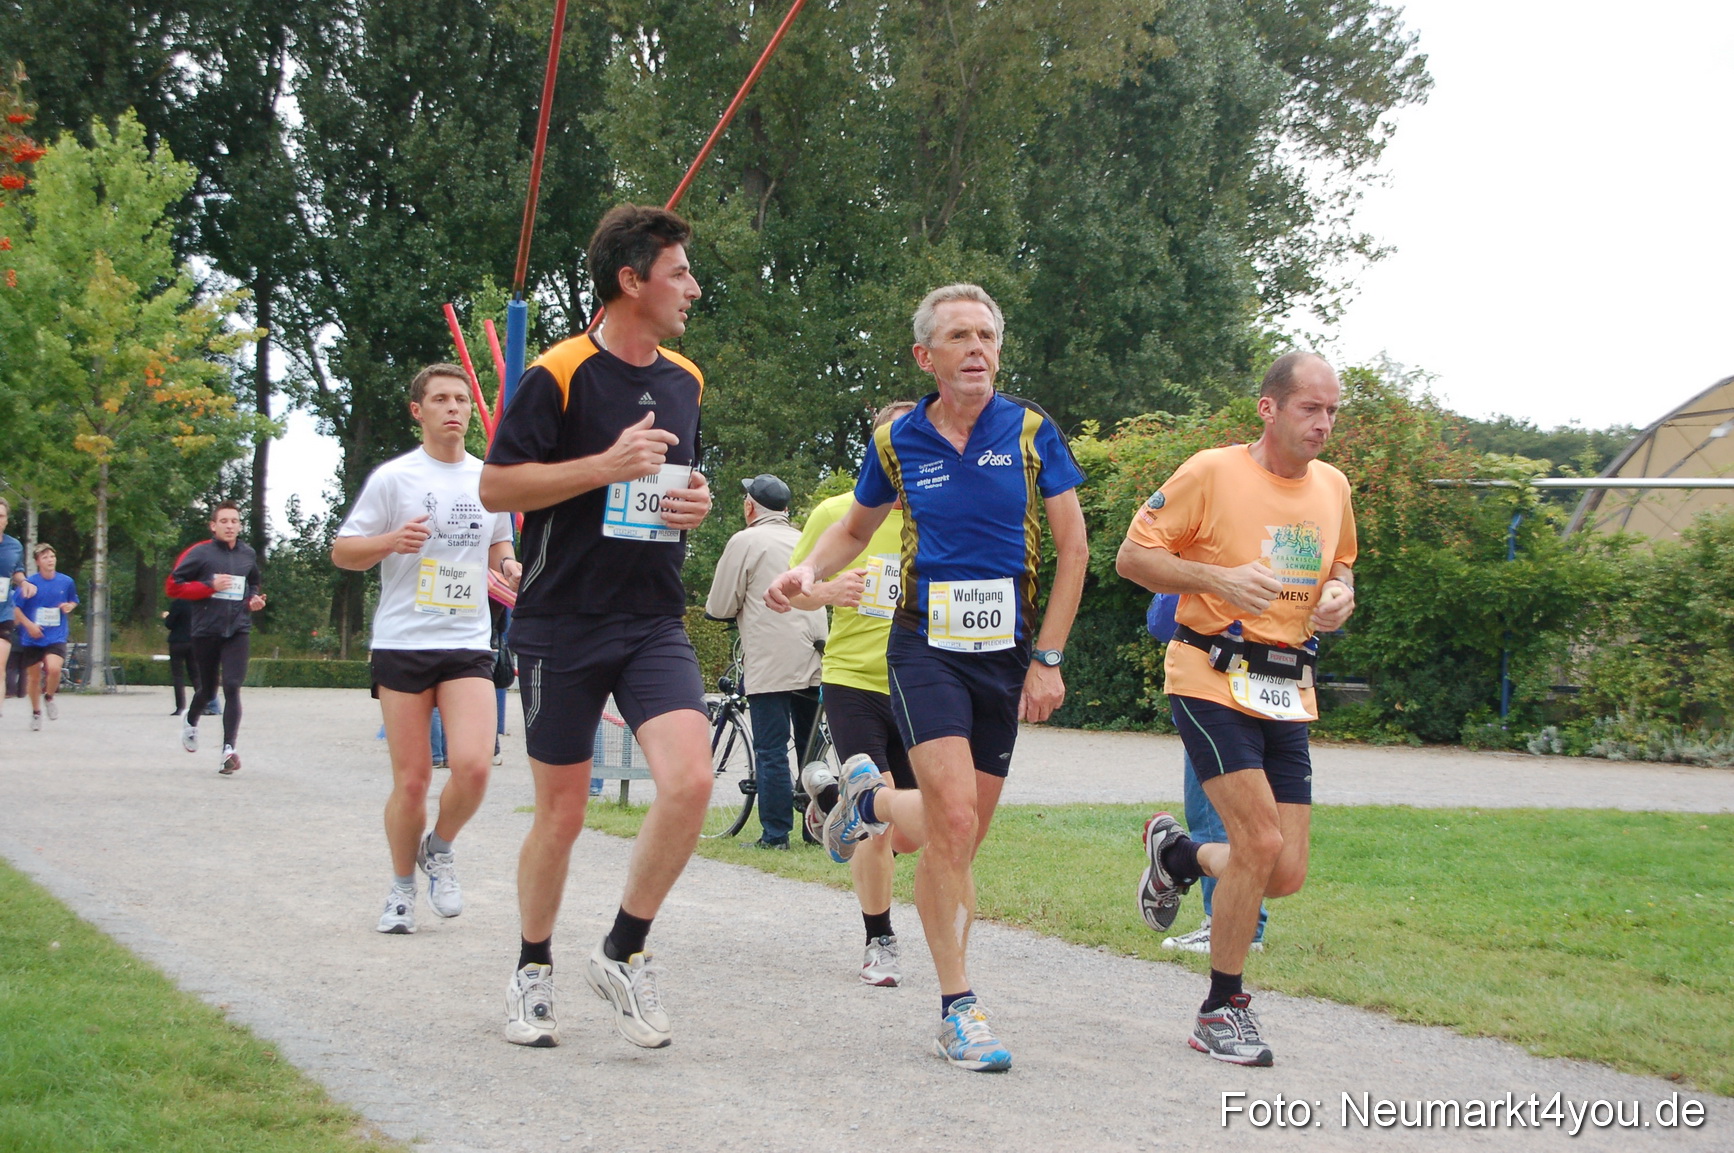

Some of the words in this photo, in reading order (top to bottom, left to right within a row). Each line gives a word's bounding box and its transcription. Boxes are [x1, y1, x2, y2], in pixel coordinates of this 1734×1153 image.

[614, 488, 621, 499] B
[438, 532, 481, 540] Neumarkter
[447, 539, 481, 547] Stadtlauf
[439, 565, 467, 580] Holger
[421, 578, 427, 587] B
[865, 579, 871, 587] B
[444, 583, 471, 599] 124
[953, 588, 1003, 604] Wolfgang
[1276, 590, 1310, 602] MENS
[932, 610, 939, 620] B
[962, 609, 1002, 629] 660
[1233, 681, 1239, 691] B
[1259, 688, 1291, 708] 466
